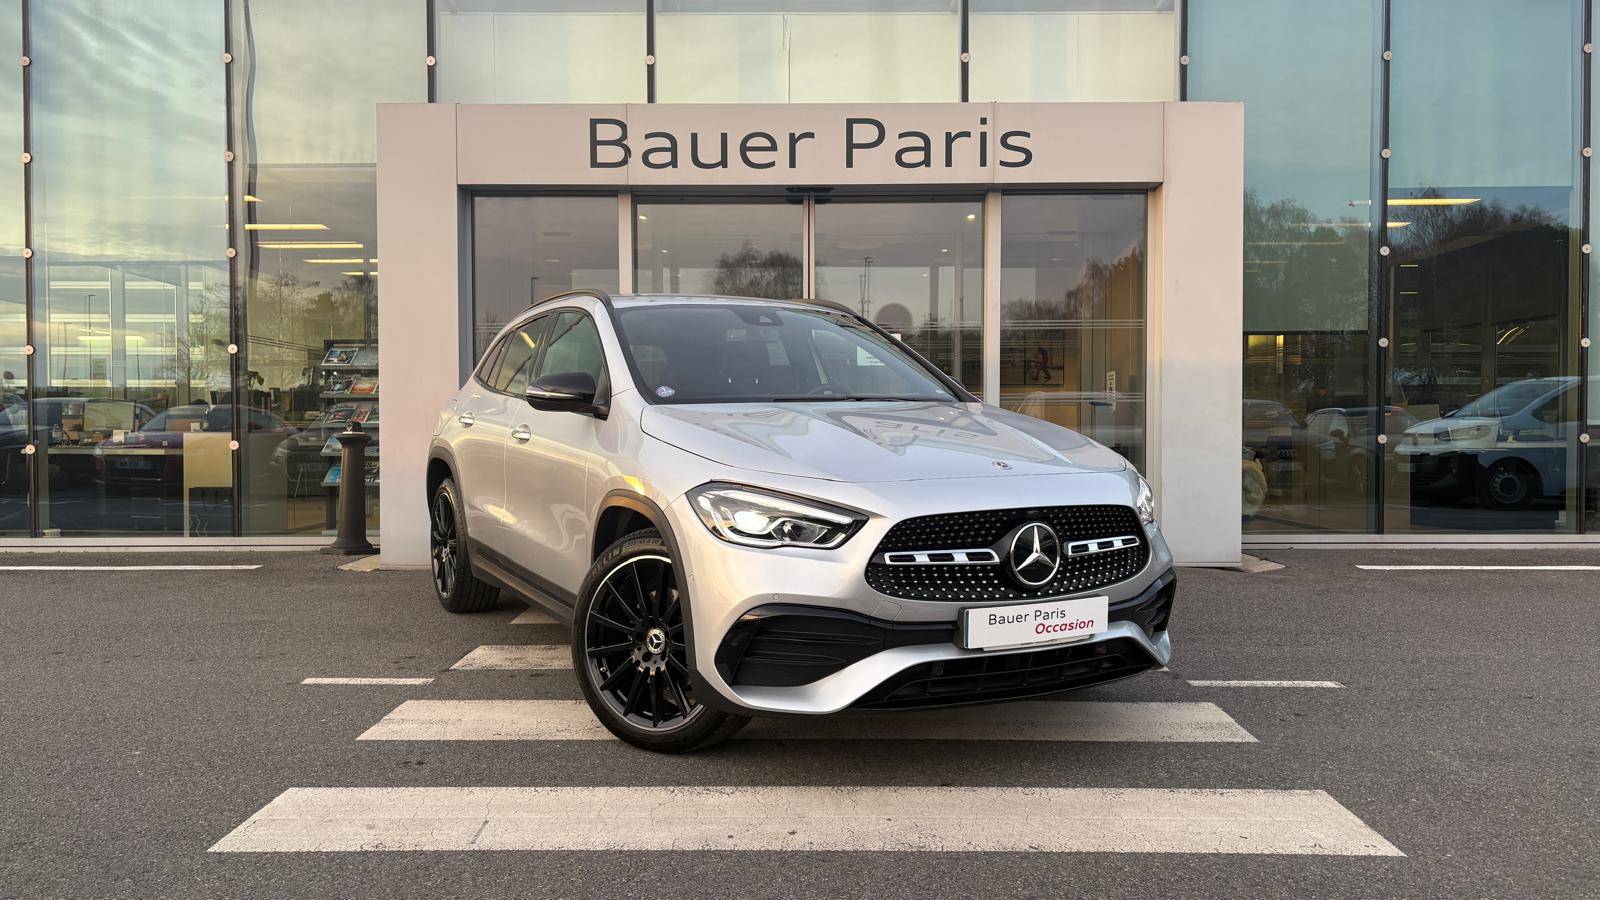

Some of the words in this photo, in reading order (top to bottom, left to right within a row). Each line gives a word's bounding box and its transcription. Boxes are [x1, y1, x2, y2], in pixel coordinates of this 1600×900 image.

[588, 117, 816, 170] Bauer
[844, 116, 1034, 169] Paris
[988, 612, 1030, 626] Bauer
[1034, 607, 1066, 621] Paris
[1035, 618, 1094, 635] Occasion
